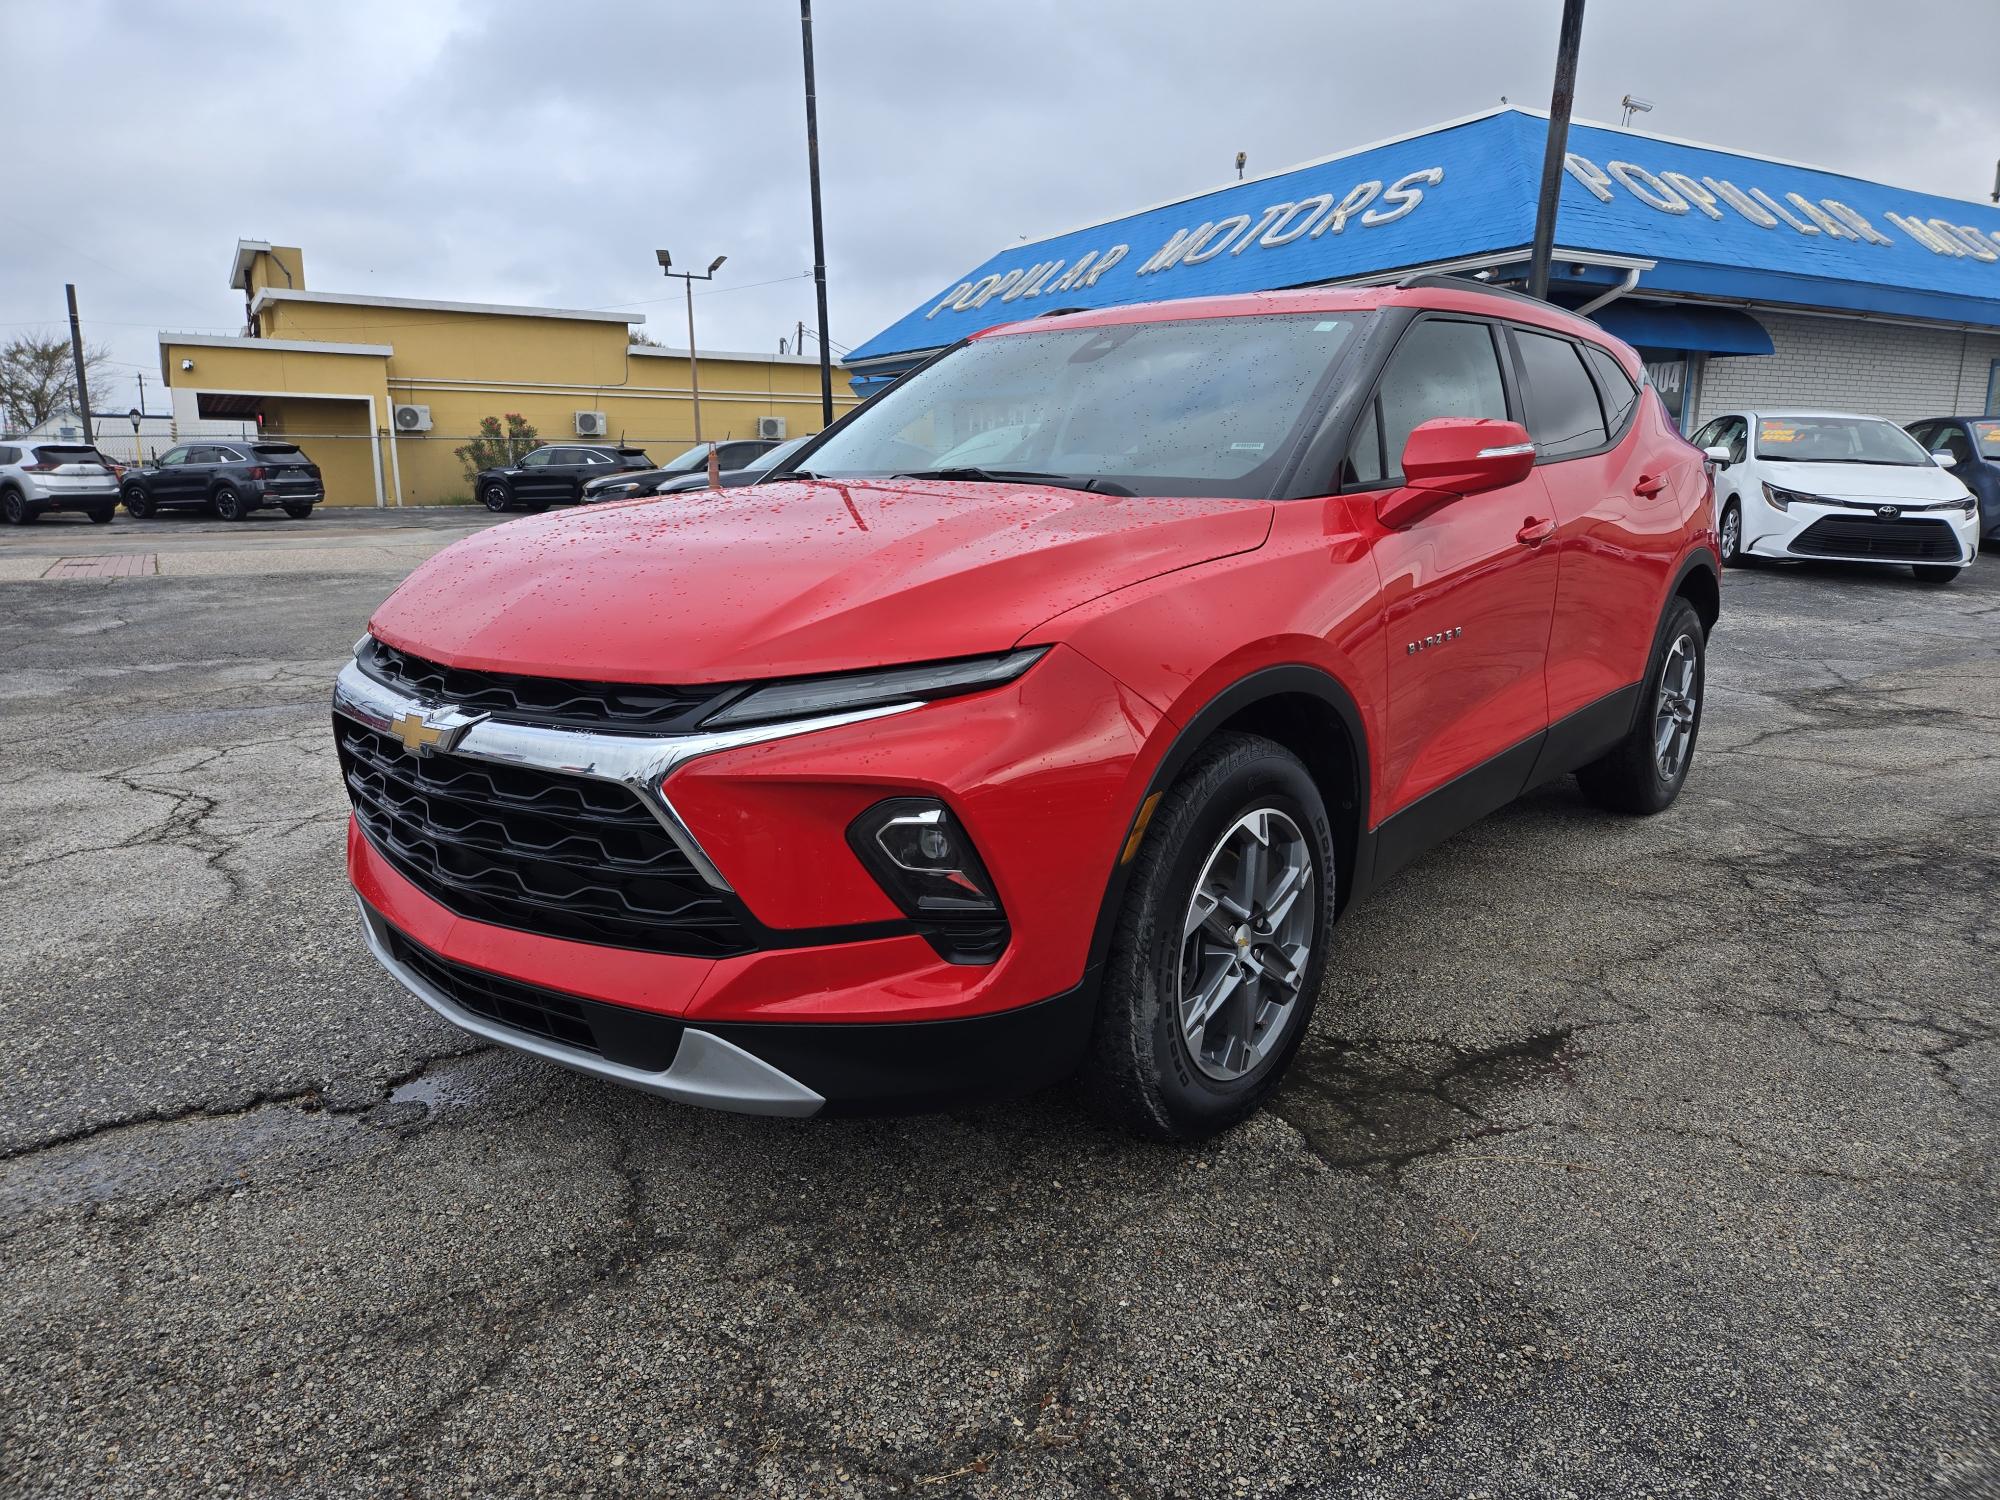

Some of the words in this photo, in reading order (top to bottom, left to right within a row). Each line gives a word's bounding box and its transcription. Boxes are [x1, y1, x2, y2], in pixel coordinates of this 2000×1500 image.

[926, 243, 1130, 320] POPULAR
[1136, 166, 1444, 276] MOTORS
[1565, 152, 1895, 247] POPULAR
[1884, 211, 2000, 262] MO
[1407, 626, 1462, 656] BLAZER
